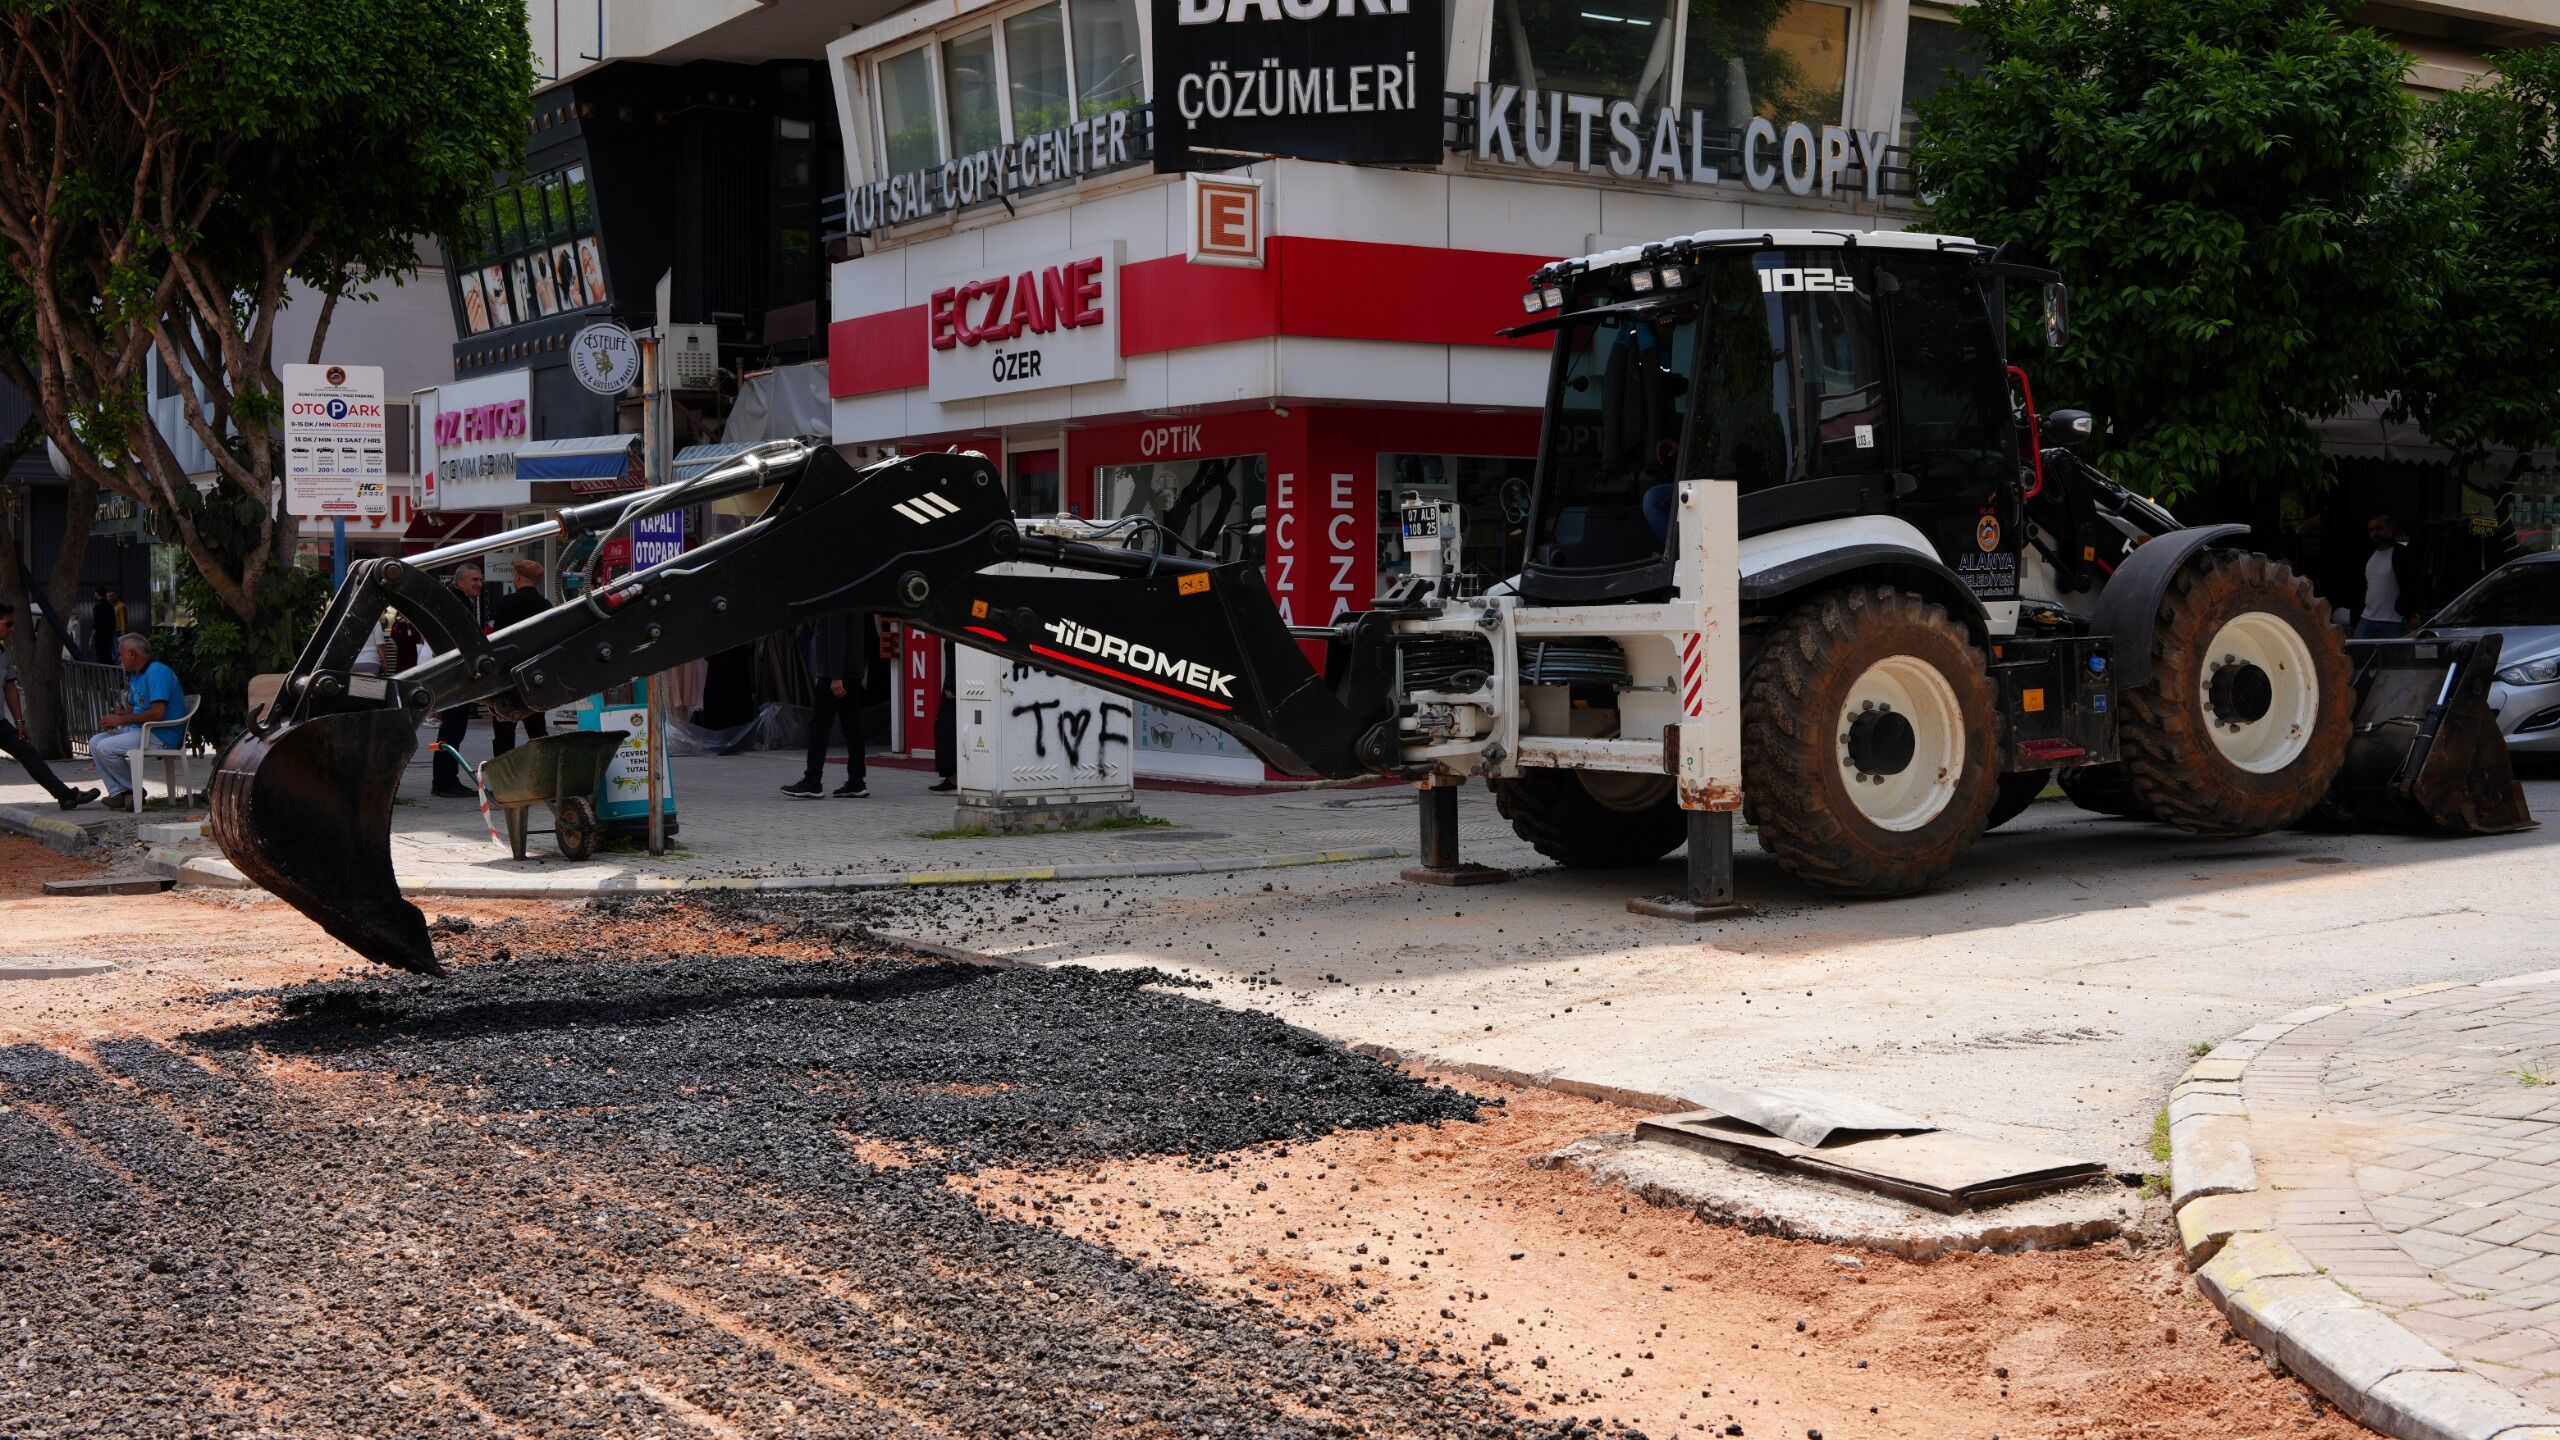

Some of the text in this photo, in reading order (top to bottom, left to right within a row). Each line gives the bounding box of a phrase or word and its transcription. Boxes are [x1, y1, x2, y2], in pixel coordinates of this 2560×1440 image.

[1178, 51, 1416, 130] ÇÖZÜMLERİ
[1474, 82, 1888, 200] KUTSAL COPY
[846, 109, 1129, 233] KUTSAL COPY CENTER
[1211, 194, 1246, 248] E
[931, 256, 1104, 351] ECZANE
[993, 348, 1042, 383] ÖZER
[292, 401, 381, 418] OTOPARK
[359, 483, 384, 491] HGS
[640, 511, 676, 533] KAPALI
[1407, 507, 1436, 522] 07 ALB
[1409, 521, 1437, 536] 108 25
[635, 541, 681, 564] OTOPARK
[1959, 552, 2016, 571] ALANYA
